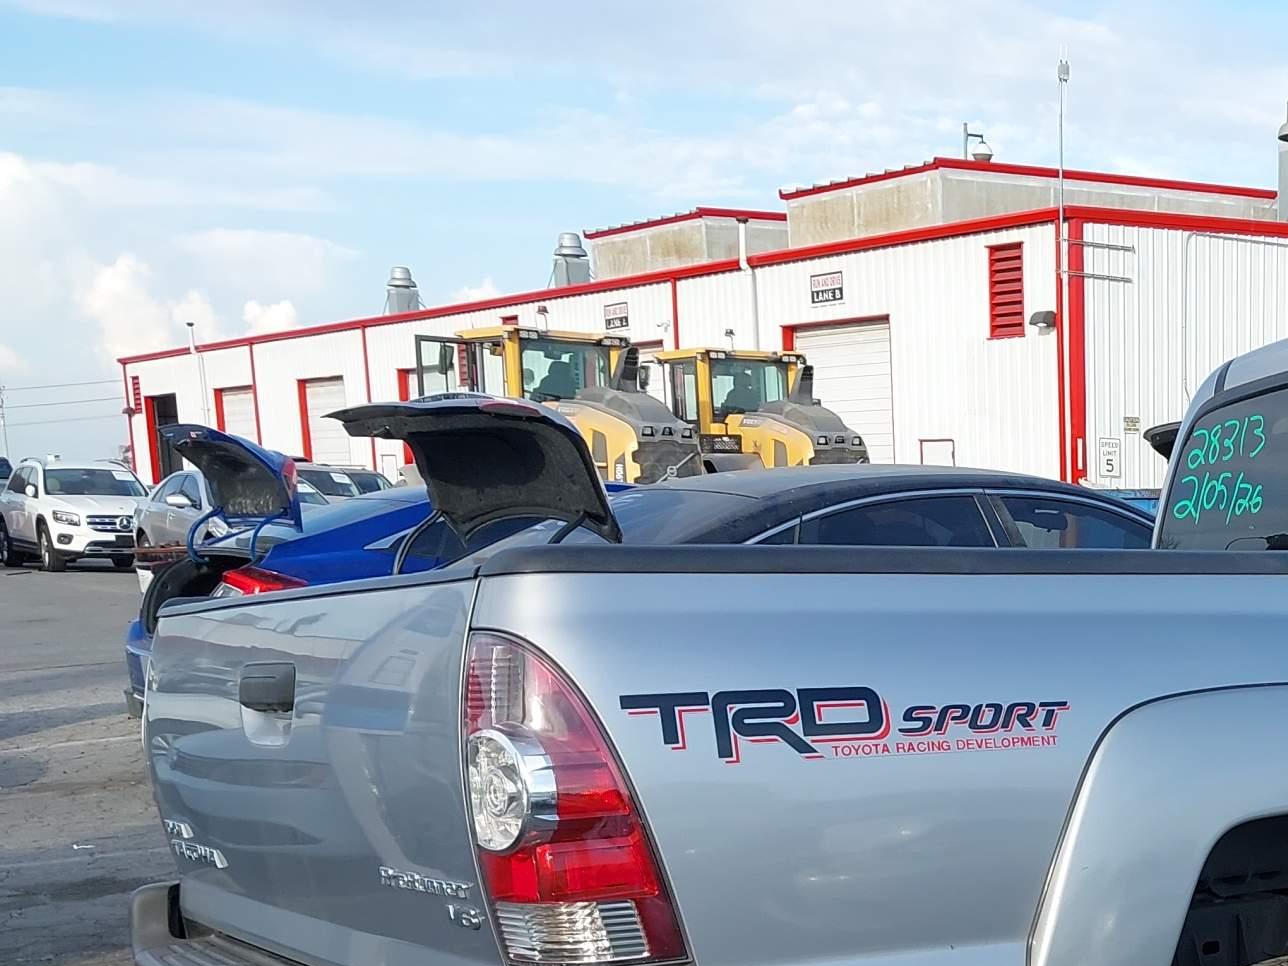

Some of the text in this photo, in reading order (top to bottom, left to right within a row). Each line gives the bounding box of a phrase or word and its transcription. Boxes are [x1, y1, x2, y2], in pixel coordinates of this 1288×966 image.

[813, 289, 841, 302] LANE B
[1187, 415, 1266, 469] 28313
[1106, 458, 1114, 473] 5
[1173, 471, 1263, 525] 2/05/26
[619, 686, 1070, 763] TRD SPORT
[832, 735, 1058, 758] TOYOTA RACING DEVELOPMENT
